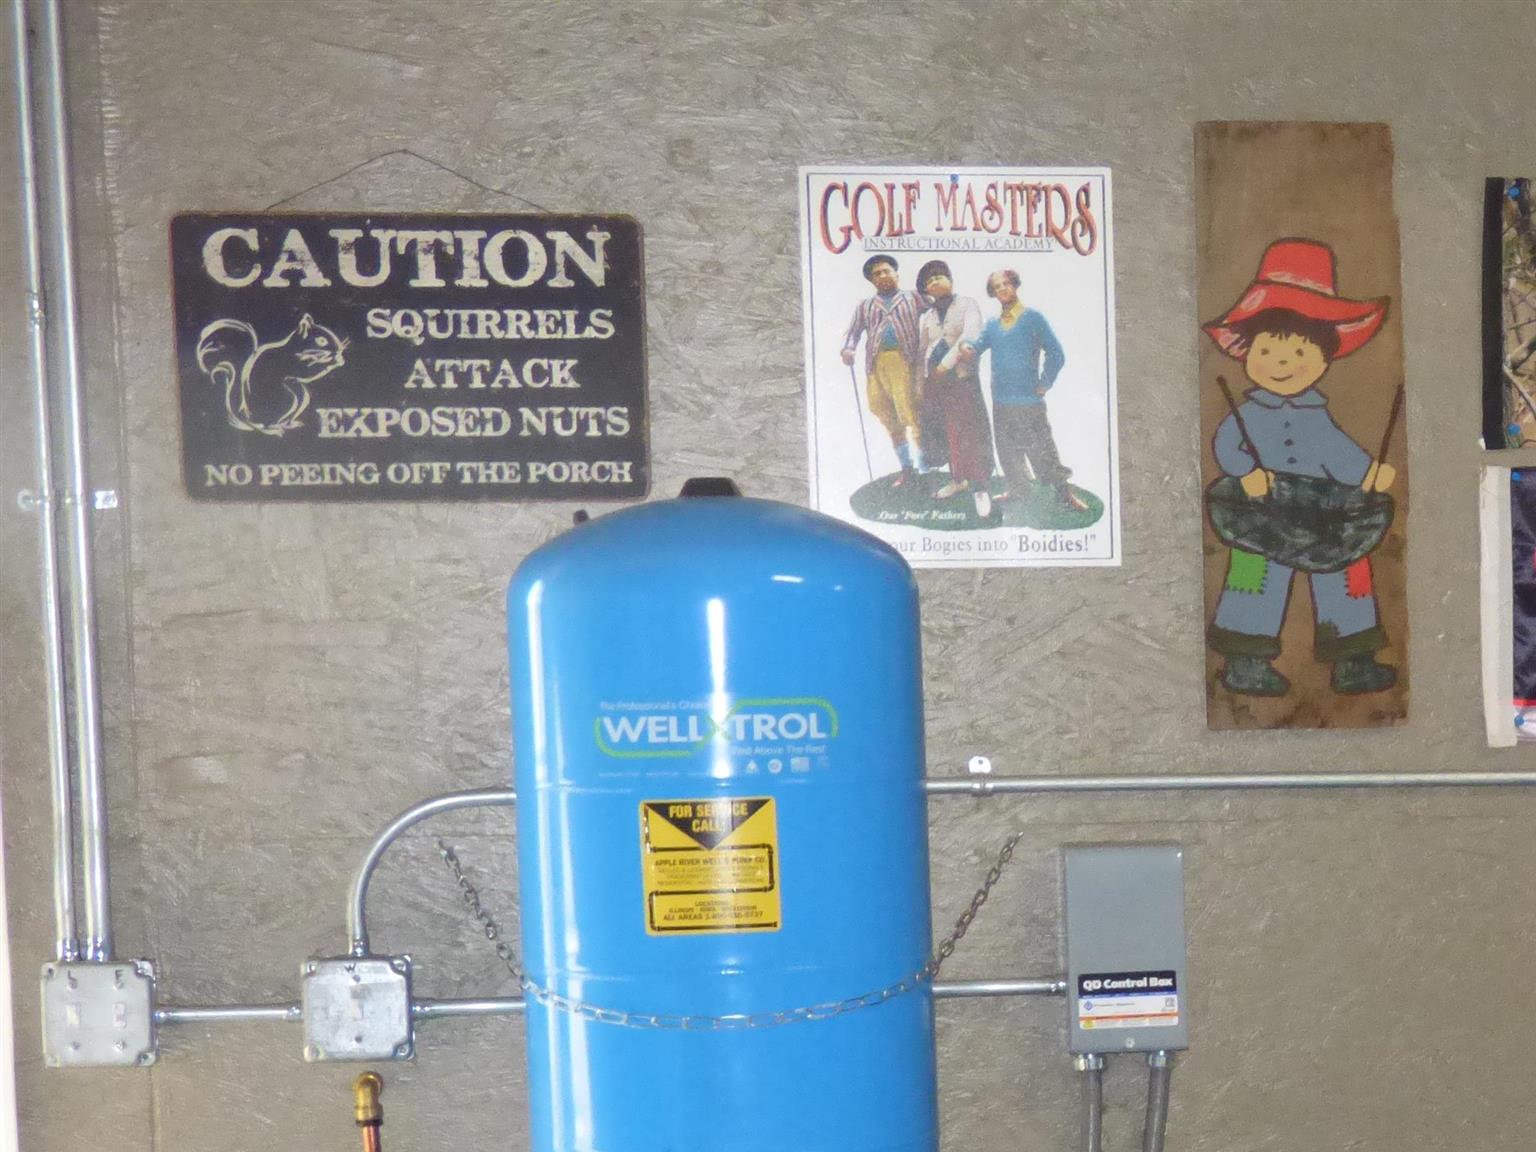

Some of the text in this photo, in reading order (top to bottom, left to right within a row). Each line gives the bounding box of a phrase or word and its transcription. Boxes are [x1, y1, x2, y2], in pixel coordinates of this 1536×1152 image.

[819, 179, 1098, 257] GOLF MASTERS
[202, 226, 612, 289] CAUTION
[863, 236, 1054, 250] INSTRUCTIONAL ACADEMY
[365, 307, 616, 346] SQUIRRELS
[403, 357, 582, 391] ATTACK
[315, 405, 631, 439] EXPOSED NUTS
[204, 460, 633, 487] NO PEEING OFF THE PORCH
[921, 536, 973, 555] Bogies
[977, 537, 1009, 552] into
[602, 714, 704, 744] WELL
[732, 712, 828, 741] TROL
[669, 804, 693, 819] FOR
[1083, 977, 1173, 991] QD Control Box
